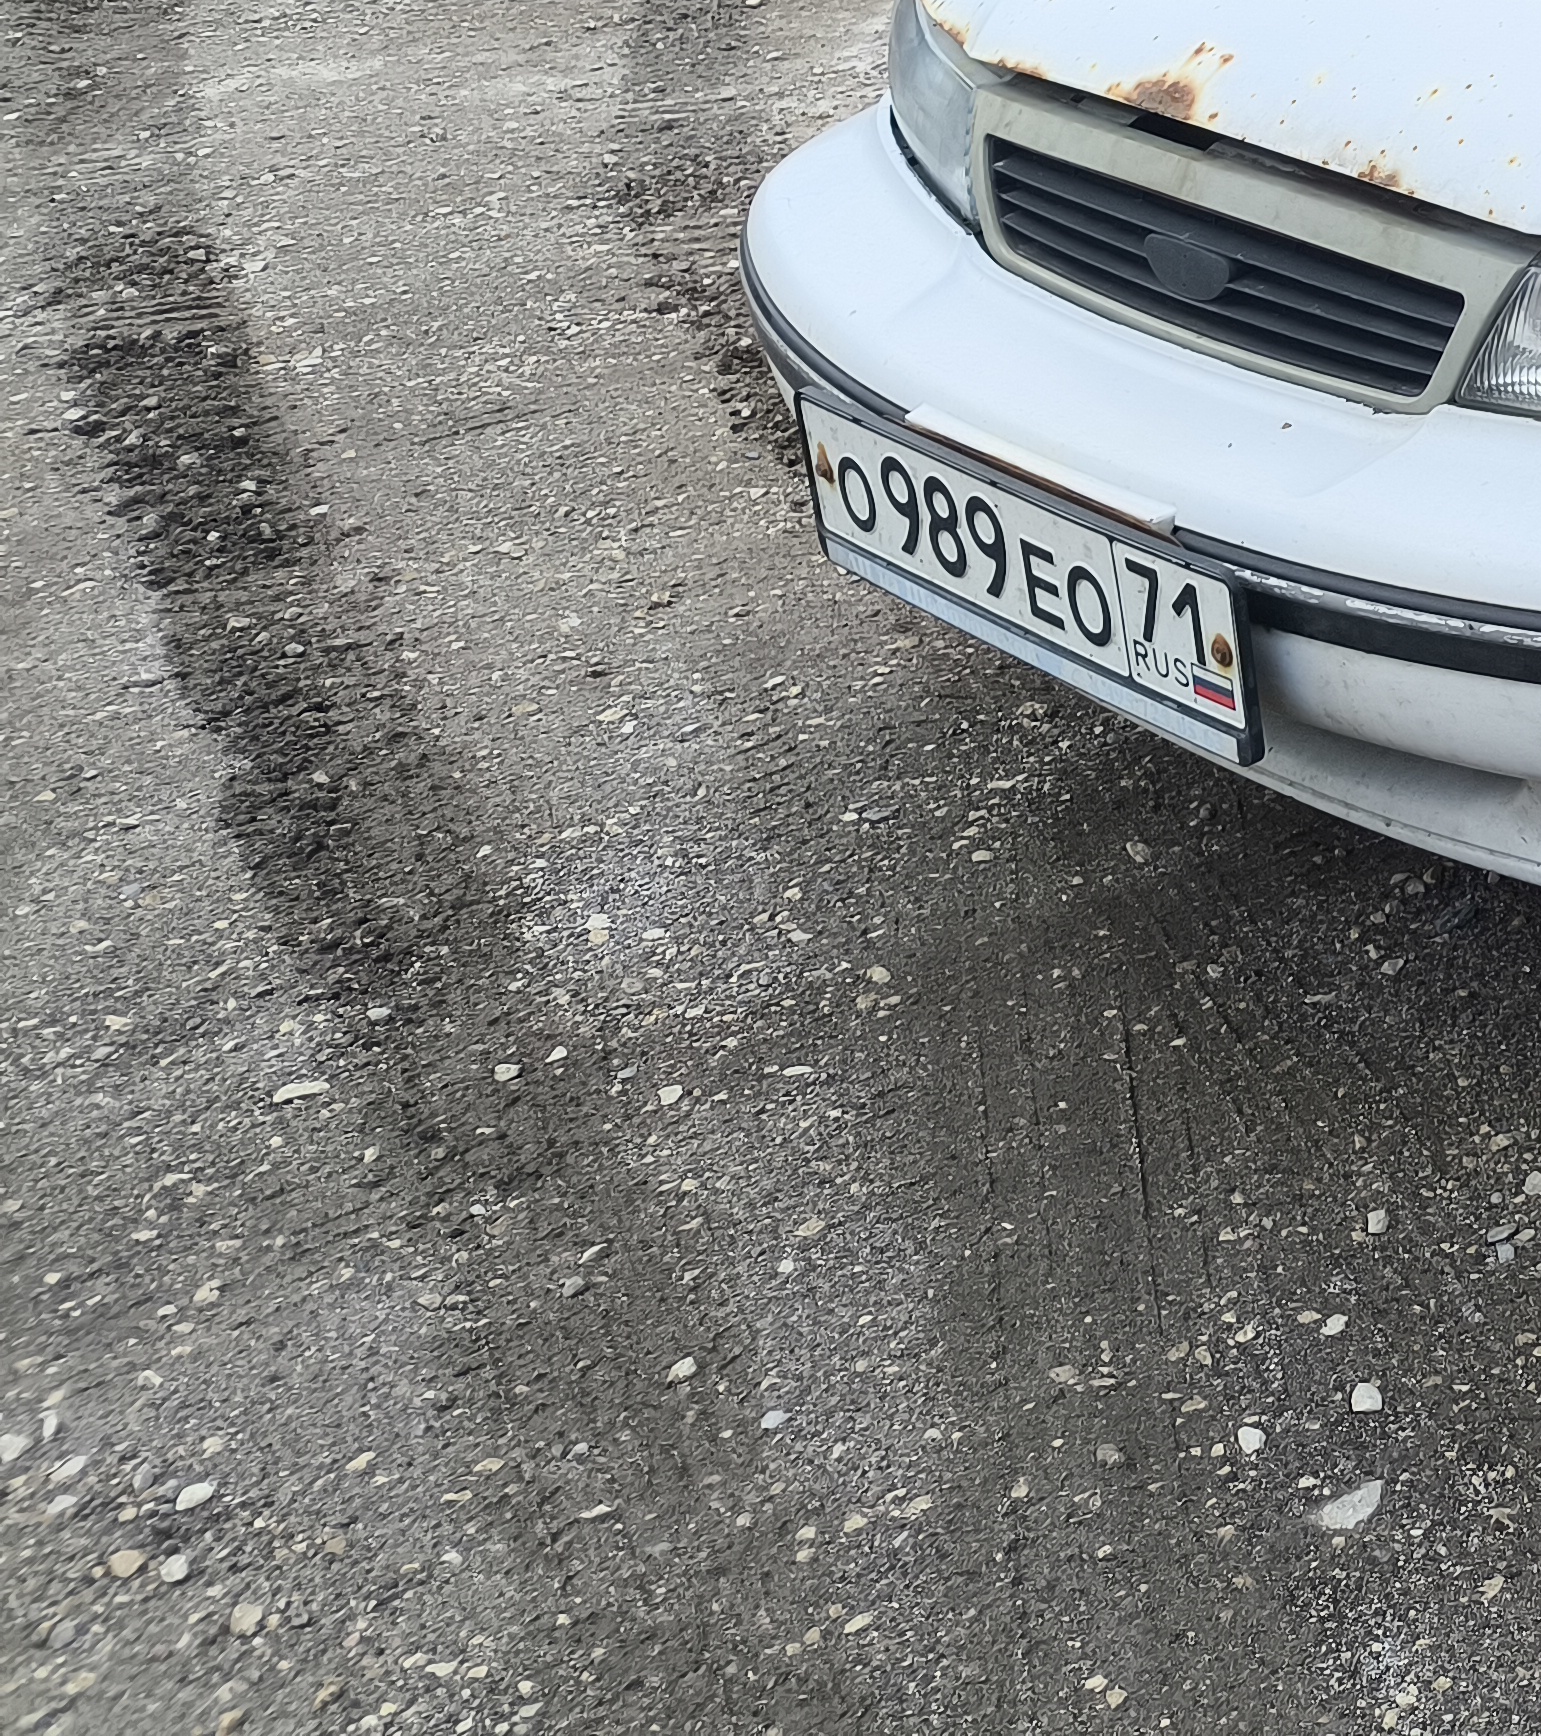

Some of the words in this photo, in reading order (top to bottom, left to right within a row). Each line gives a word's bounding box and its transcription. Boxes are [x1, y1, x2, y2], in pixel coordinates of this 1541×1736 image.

[837, 455, 1112, 647] О989ЕО
[1124, 556, 1207, 666] 71
[1132, 638, 1191, 689] RUS
